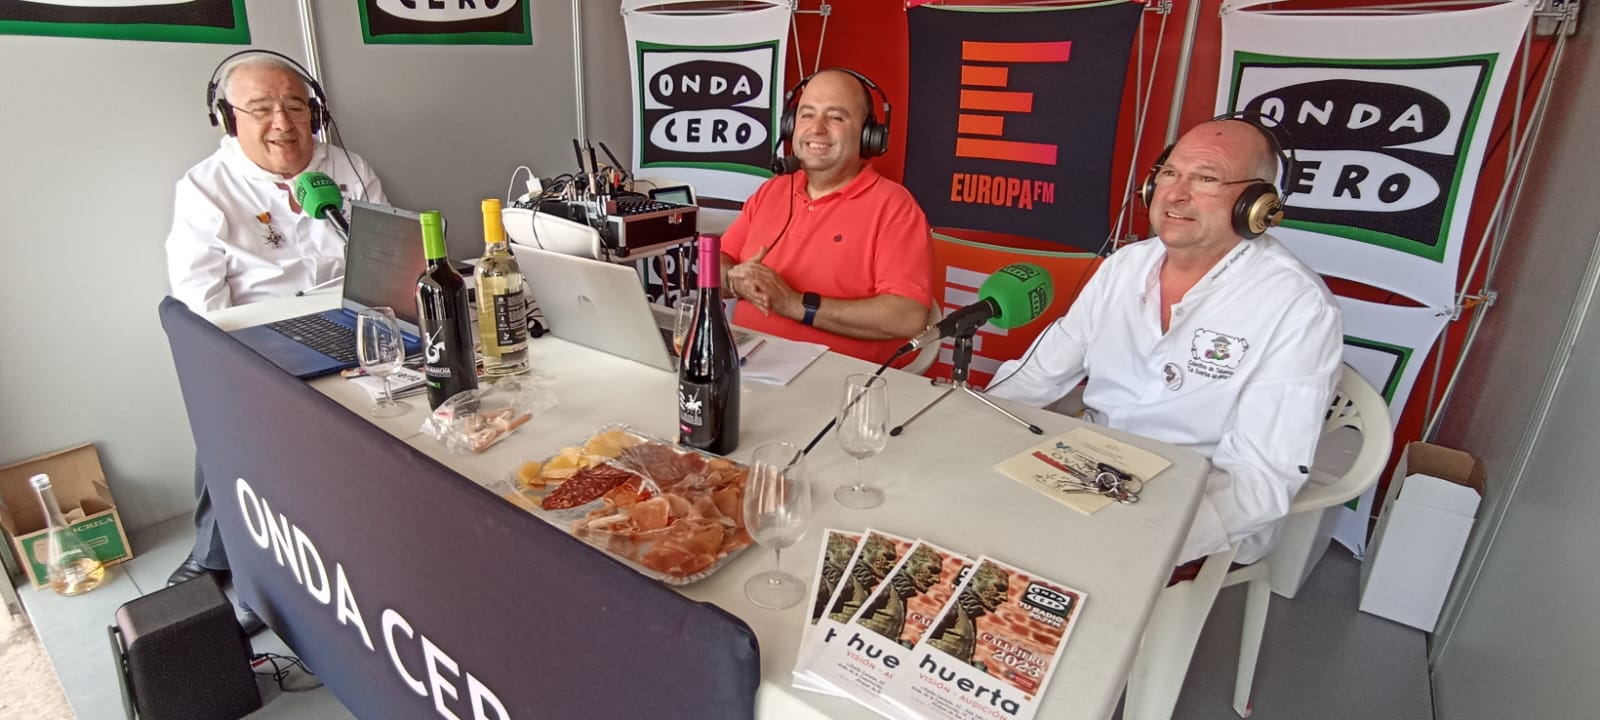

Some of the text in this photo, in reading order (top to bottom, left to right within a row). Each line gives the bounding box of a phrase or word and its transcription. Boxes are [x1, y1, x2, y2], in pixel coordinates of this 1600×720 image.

[659, 74, 751, 96] ONDA
[665, 118, 751, 144] CERO
[1260, 97, 1424, 133] ONDA
[1292, 161, 1411, 203] ERO
[236, 477, 375, 651] ONDA
[1032, 605, 1065, 624] RADIO
[982, 633, 1045, 666] CALLEJERO
[993, 650, 1041, 678] 2023
[919, 654, 1020, 716] huerta
